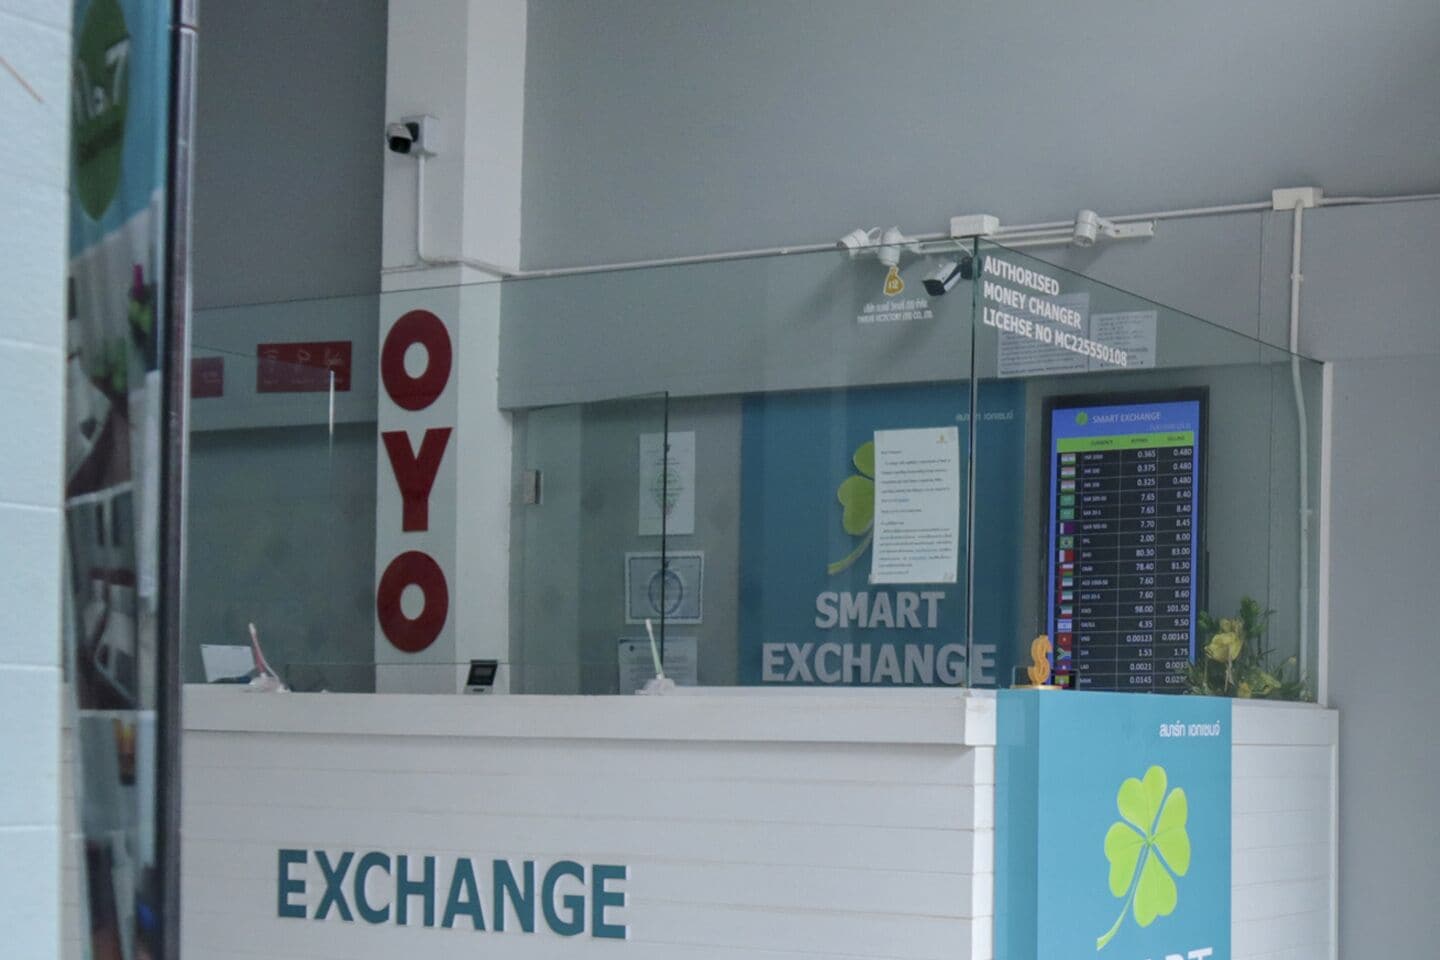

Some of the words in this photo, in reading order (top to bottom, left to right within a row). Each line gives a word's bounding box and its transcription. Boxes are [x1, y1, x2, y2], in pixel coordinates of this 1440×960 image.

[983, 255, 1061, 297] AUTHORISED
[983, 281, 1027, 310] MONEY
[1028, 296, 1082, 330] CHANGER
[1035, 323, 1052, 344] NO
[1092, 412, 1119, 424] SMART
[1120, 411, 1162, 423] EXCHANGE
[377, 309, 453, 653] OYO
[814, 591, 946, 630] SMART
[761, 641, 998, 685] EXCHANGE
[277, 848, 628, 939] EXCHANGE
